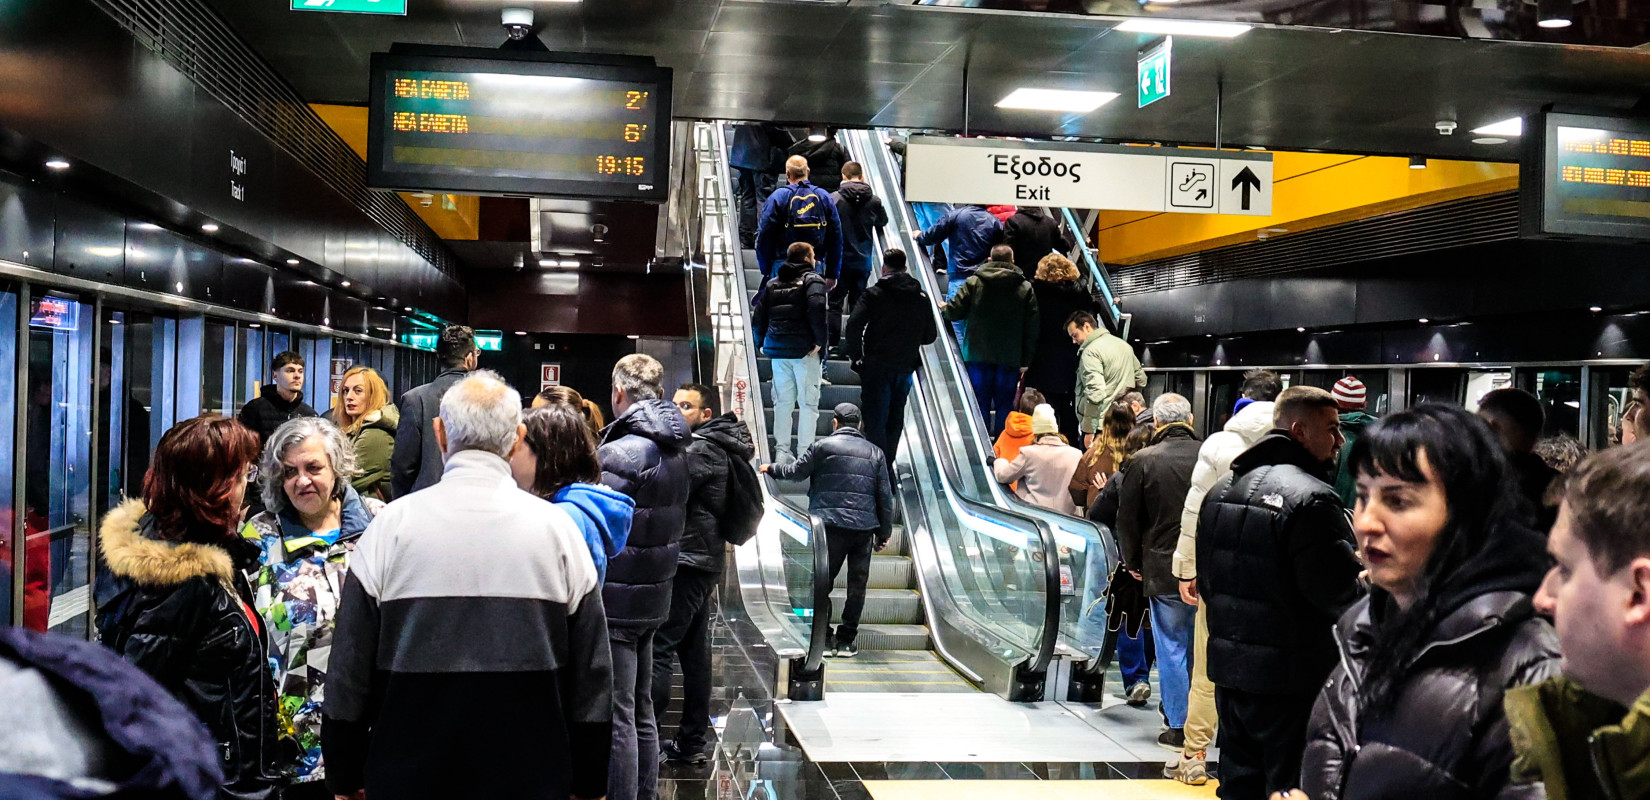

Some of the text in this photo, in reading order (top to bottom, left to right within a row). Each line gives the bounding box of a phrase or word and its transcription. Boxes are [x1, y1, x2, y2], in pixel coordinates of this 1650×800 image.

[626, 90, 648, 110] 2'
[596, 155, 644, 175] 19:15
[987, 154, 1081, 183] Έξοδος
[1016, 184, 1051, 201] Exit
